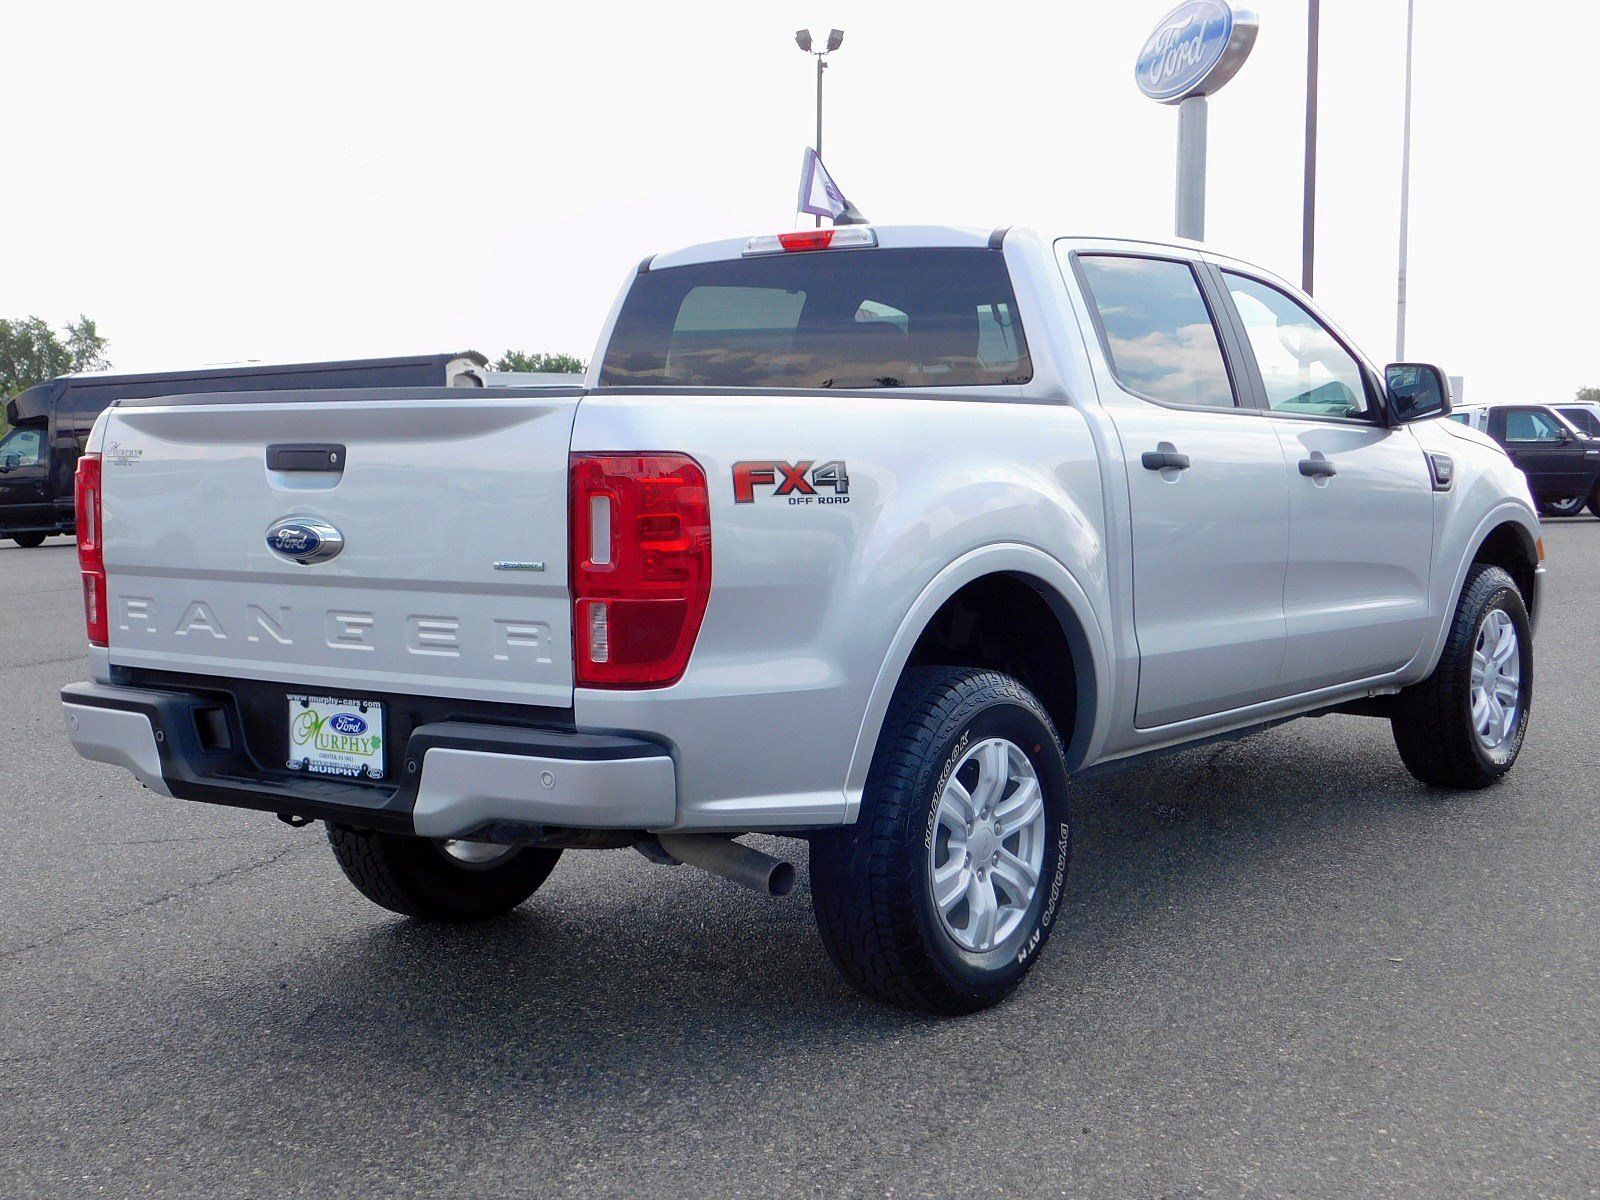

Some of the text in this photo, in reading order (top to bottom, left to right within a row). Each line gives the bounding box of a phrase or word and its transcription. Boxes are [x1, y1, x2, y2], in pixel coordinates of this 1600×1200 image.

[1149, 14, 1207, 85] Ford
[731, 460, 850, 505] FX4
[788, 496, 850, 506] OFF ROAD
[275, 528, 308, 550] Ford
[118, 594, 552, 664] RANGER
[292, 709, 371, 753] MURPHY
[335, 715, 361, 733] Ford
[308, 764, 361, 777] MURPHY
